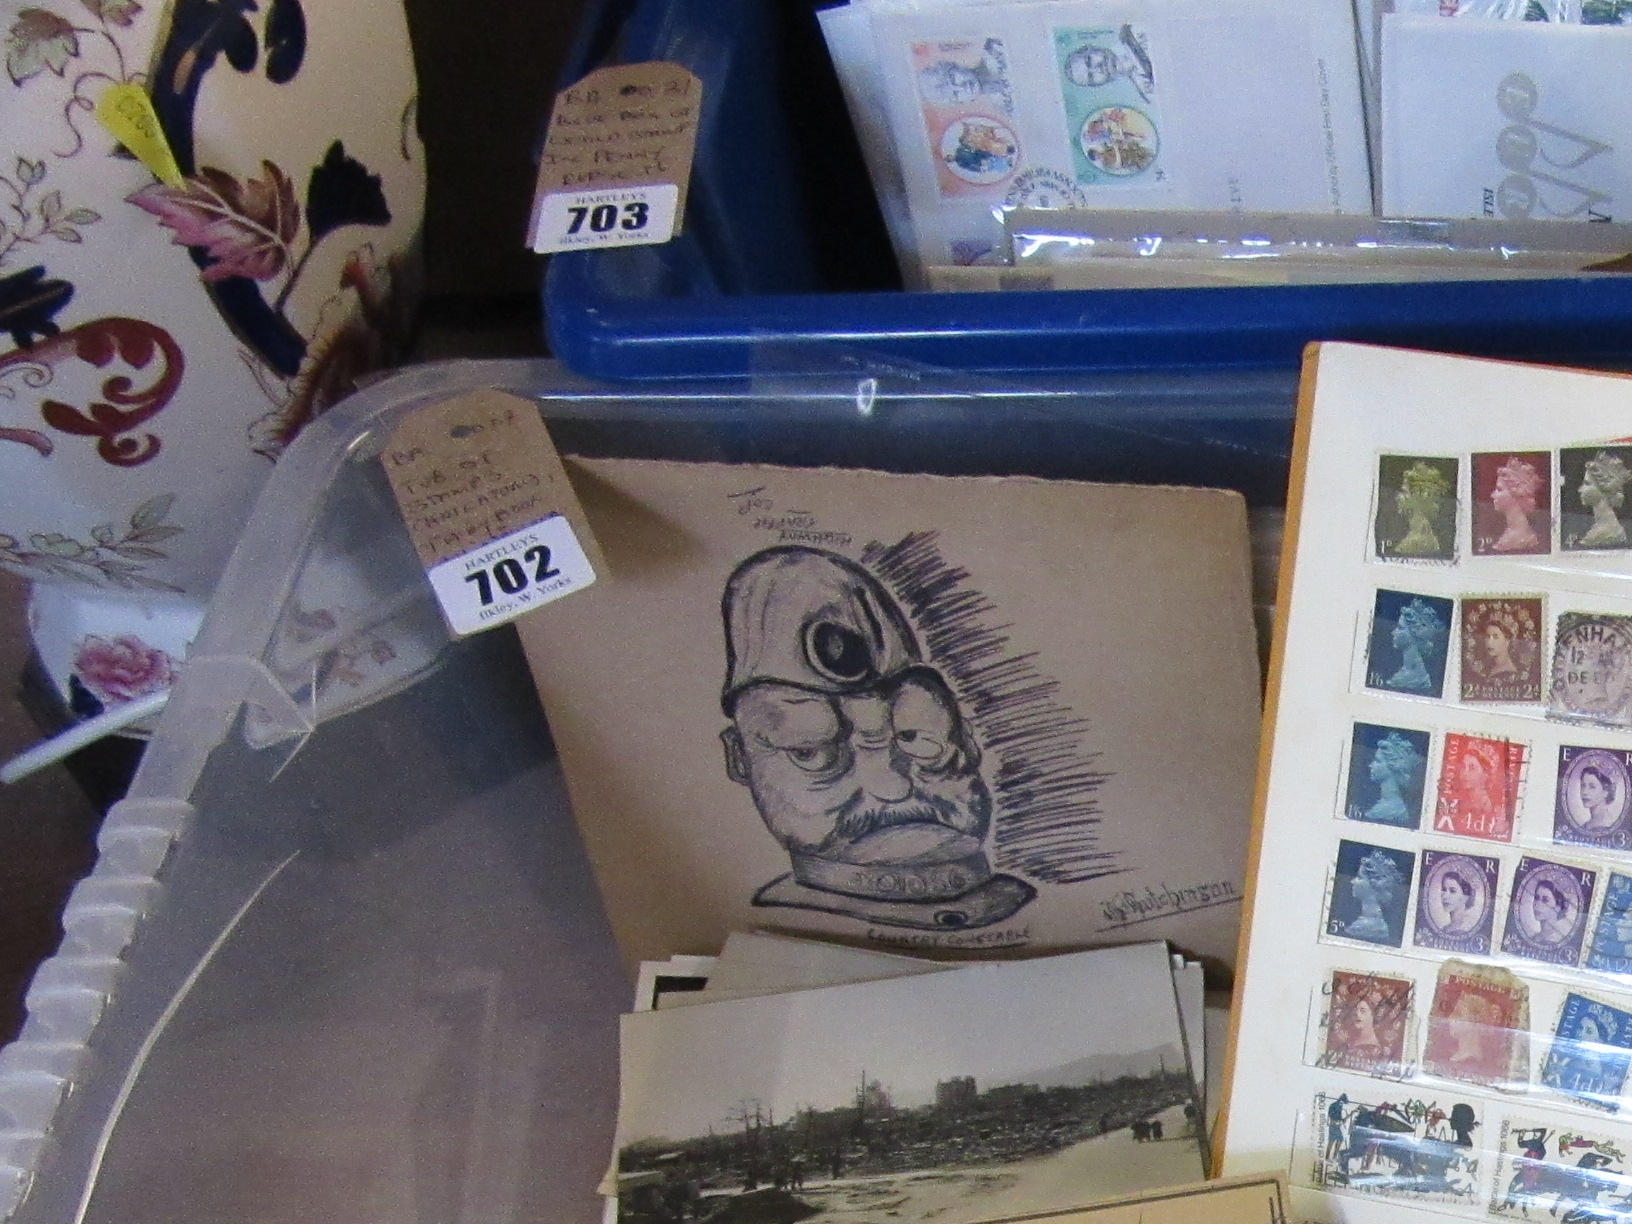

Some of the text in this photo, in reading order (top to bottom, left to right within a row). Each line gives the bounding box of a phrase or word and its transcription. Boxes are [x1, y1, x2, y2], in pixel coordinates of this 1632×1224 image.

[575, 191, 648, 205] HARTLEYS
[1482, 186, 1495, 217] ISLE
[566, 202, 651, 236] 703
[464, 532, 540, 571] HARTLEYS
[464, 543, 561, 606] 702
[535, 576, 573, 596] Yorks
[1562, 749, 1571, 761] E
[1424, 851, 1434, 866] E
[1485, 859, 1497, 873] R
[1518, 858, 1529, 872] E
[1580, 871, 1593, 886] R
[1500, 1119, 1510, 1139] 1066
